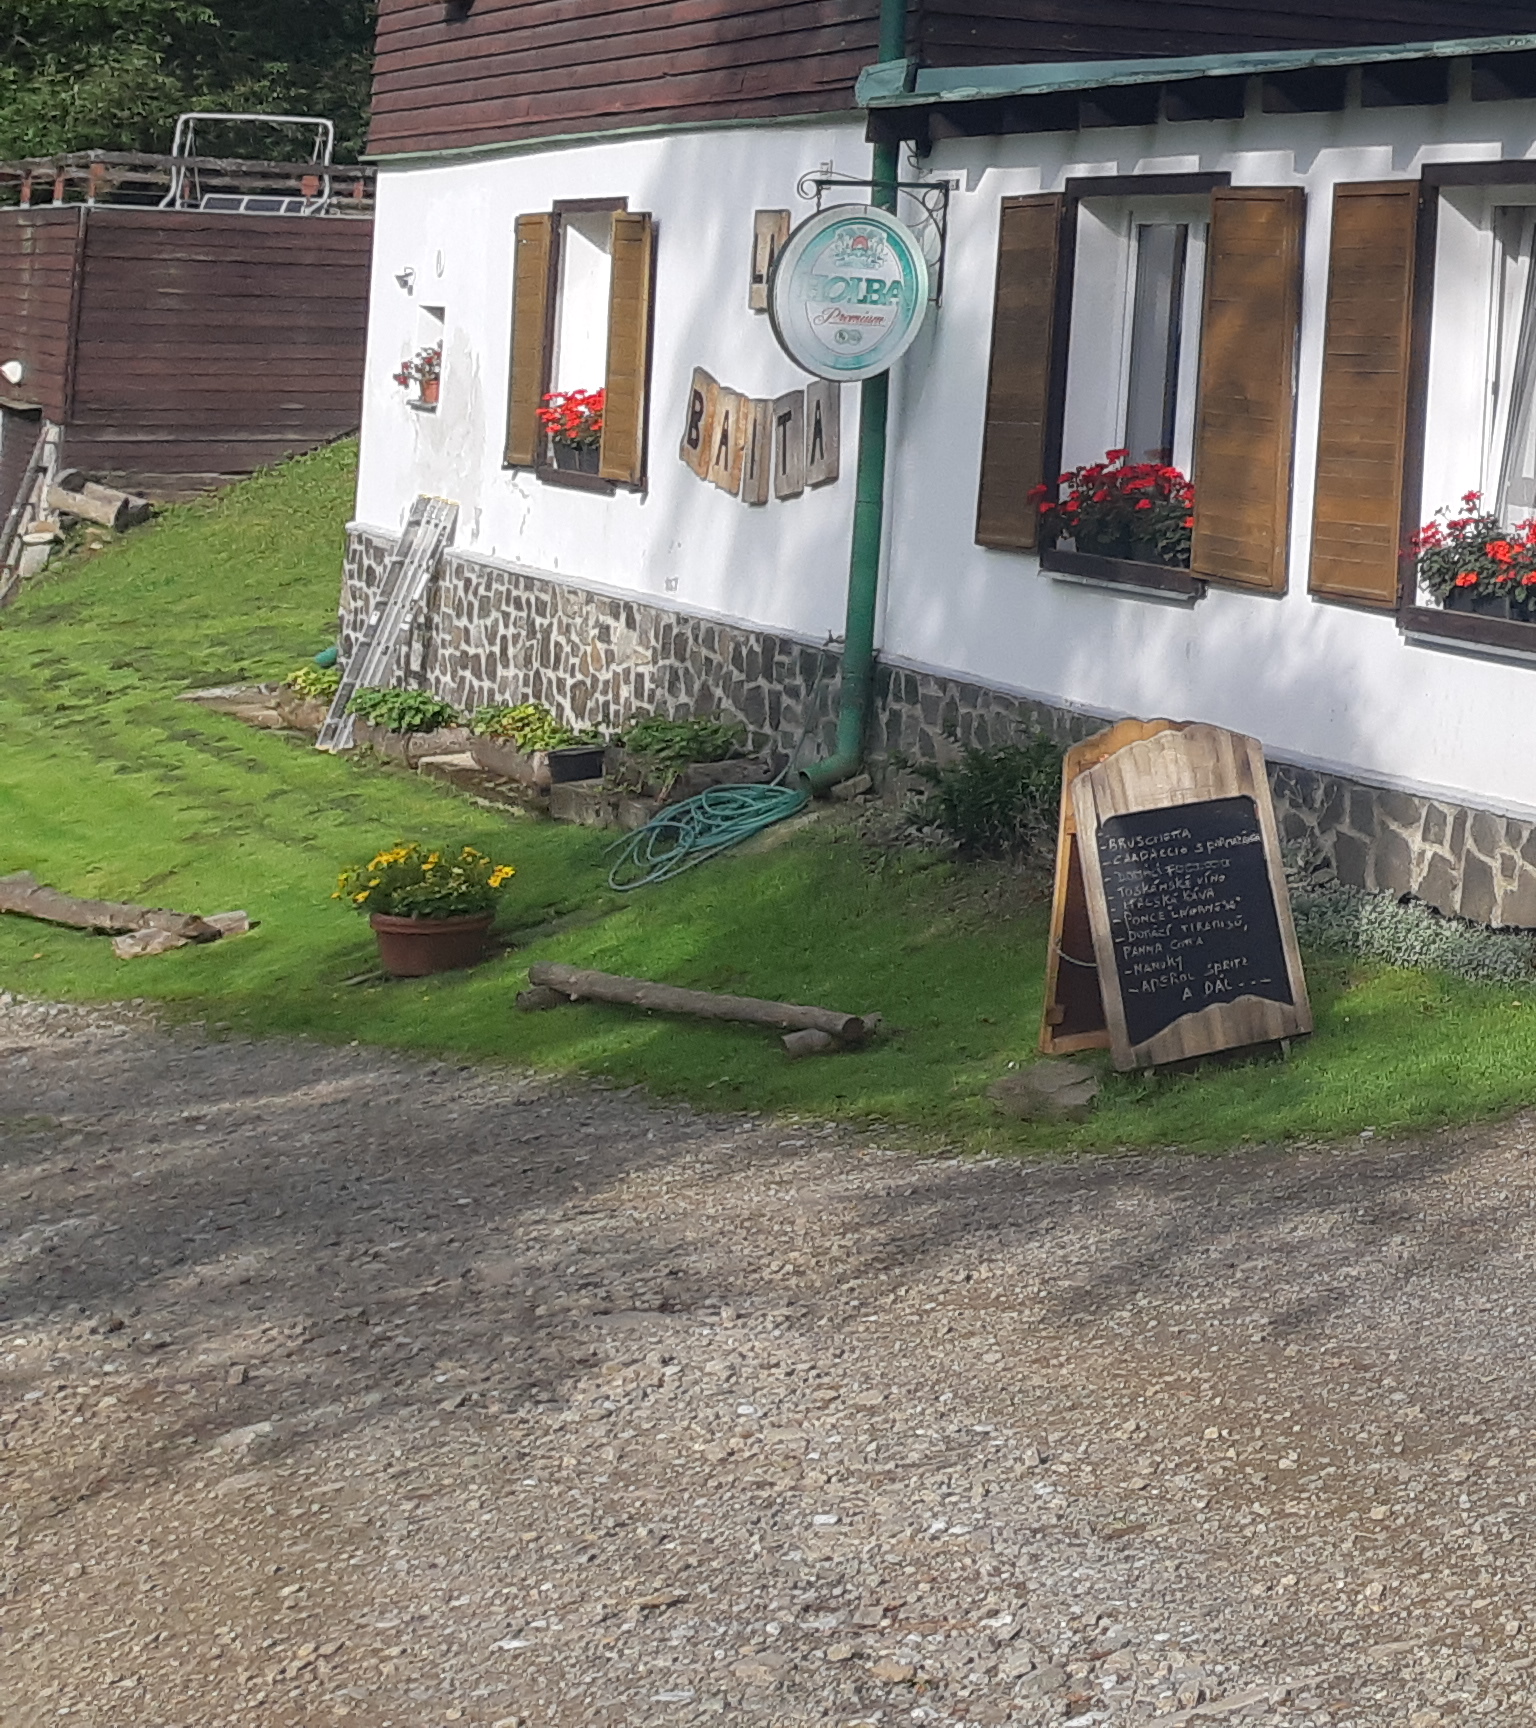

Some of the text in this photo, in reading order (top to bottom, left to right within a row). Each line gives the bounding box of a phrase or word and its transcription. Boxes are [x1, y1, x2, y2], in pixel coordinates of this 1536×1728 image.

[801, 273, 903, 305] HOLBA
[813, 307, 885, 326] Premium
[686, 388, 825, 480] BAITA
